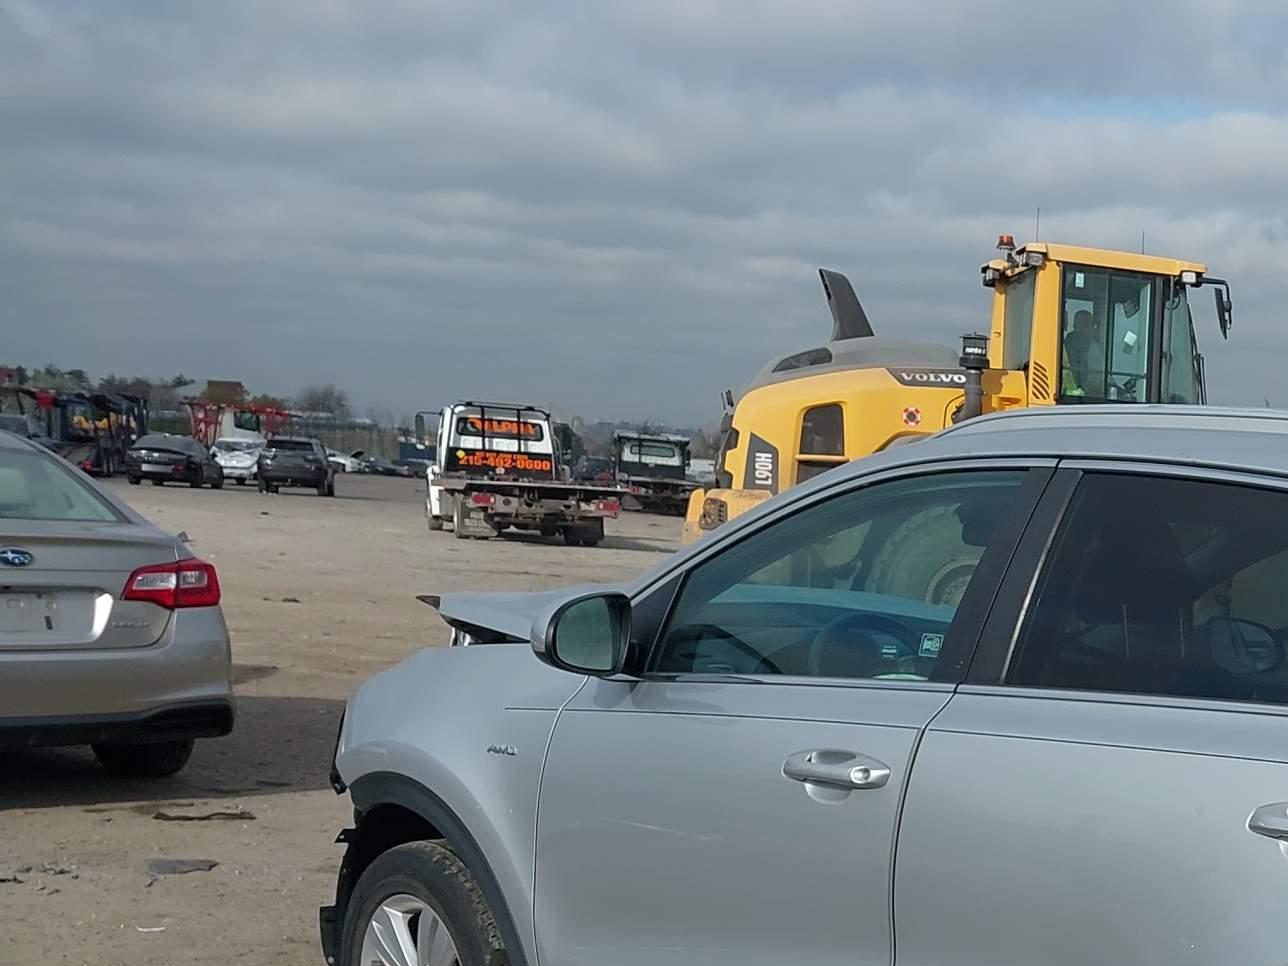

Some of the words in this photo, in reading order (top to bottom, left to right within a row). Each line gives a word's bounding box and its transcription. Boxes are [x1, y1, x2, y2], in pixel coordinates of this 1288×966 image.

[900, 372, 967, 384] VOLVO
[754, 452, 773, 485] L90H
[486, 744, 517, 756] AWD
